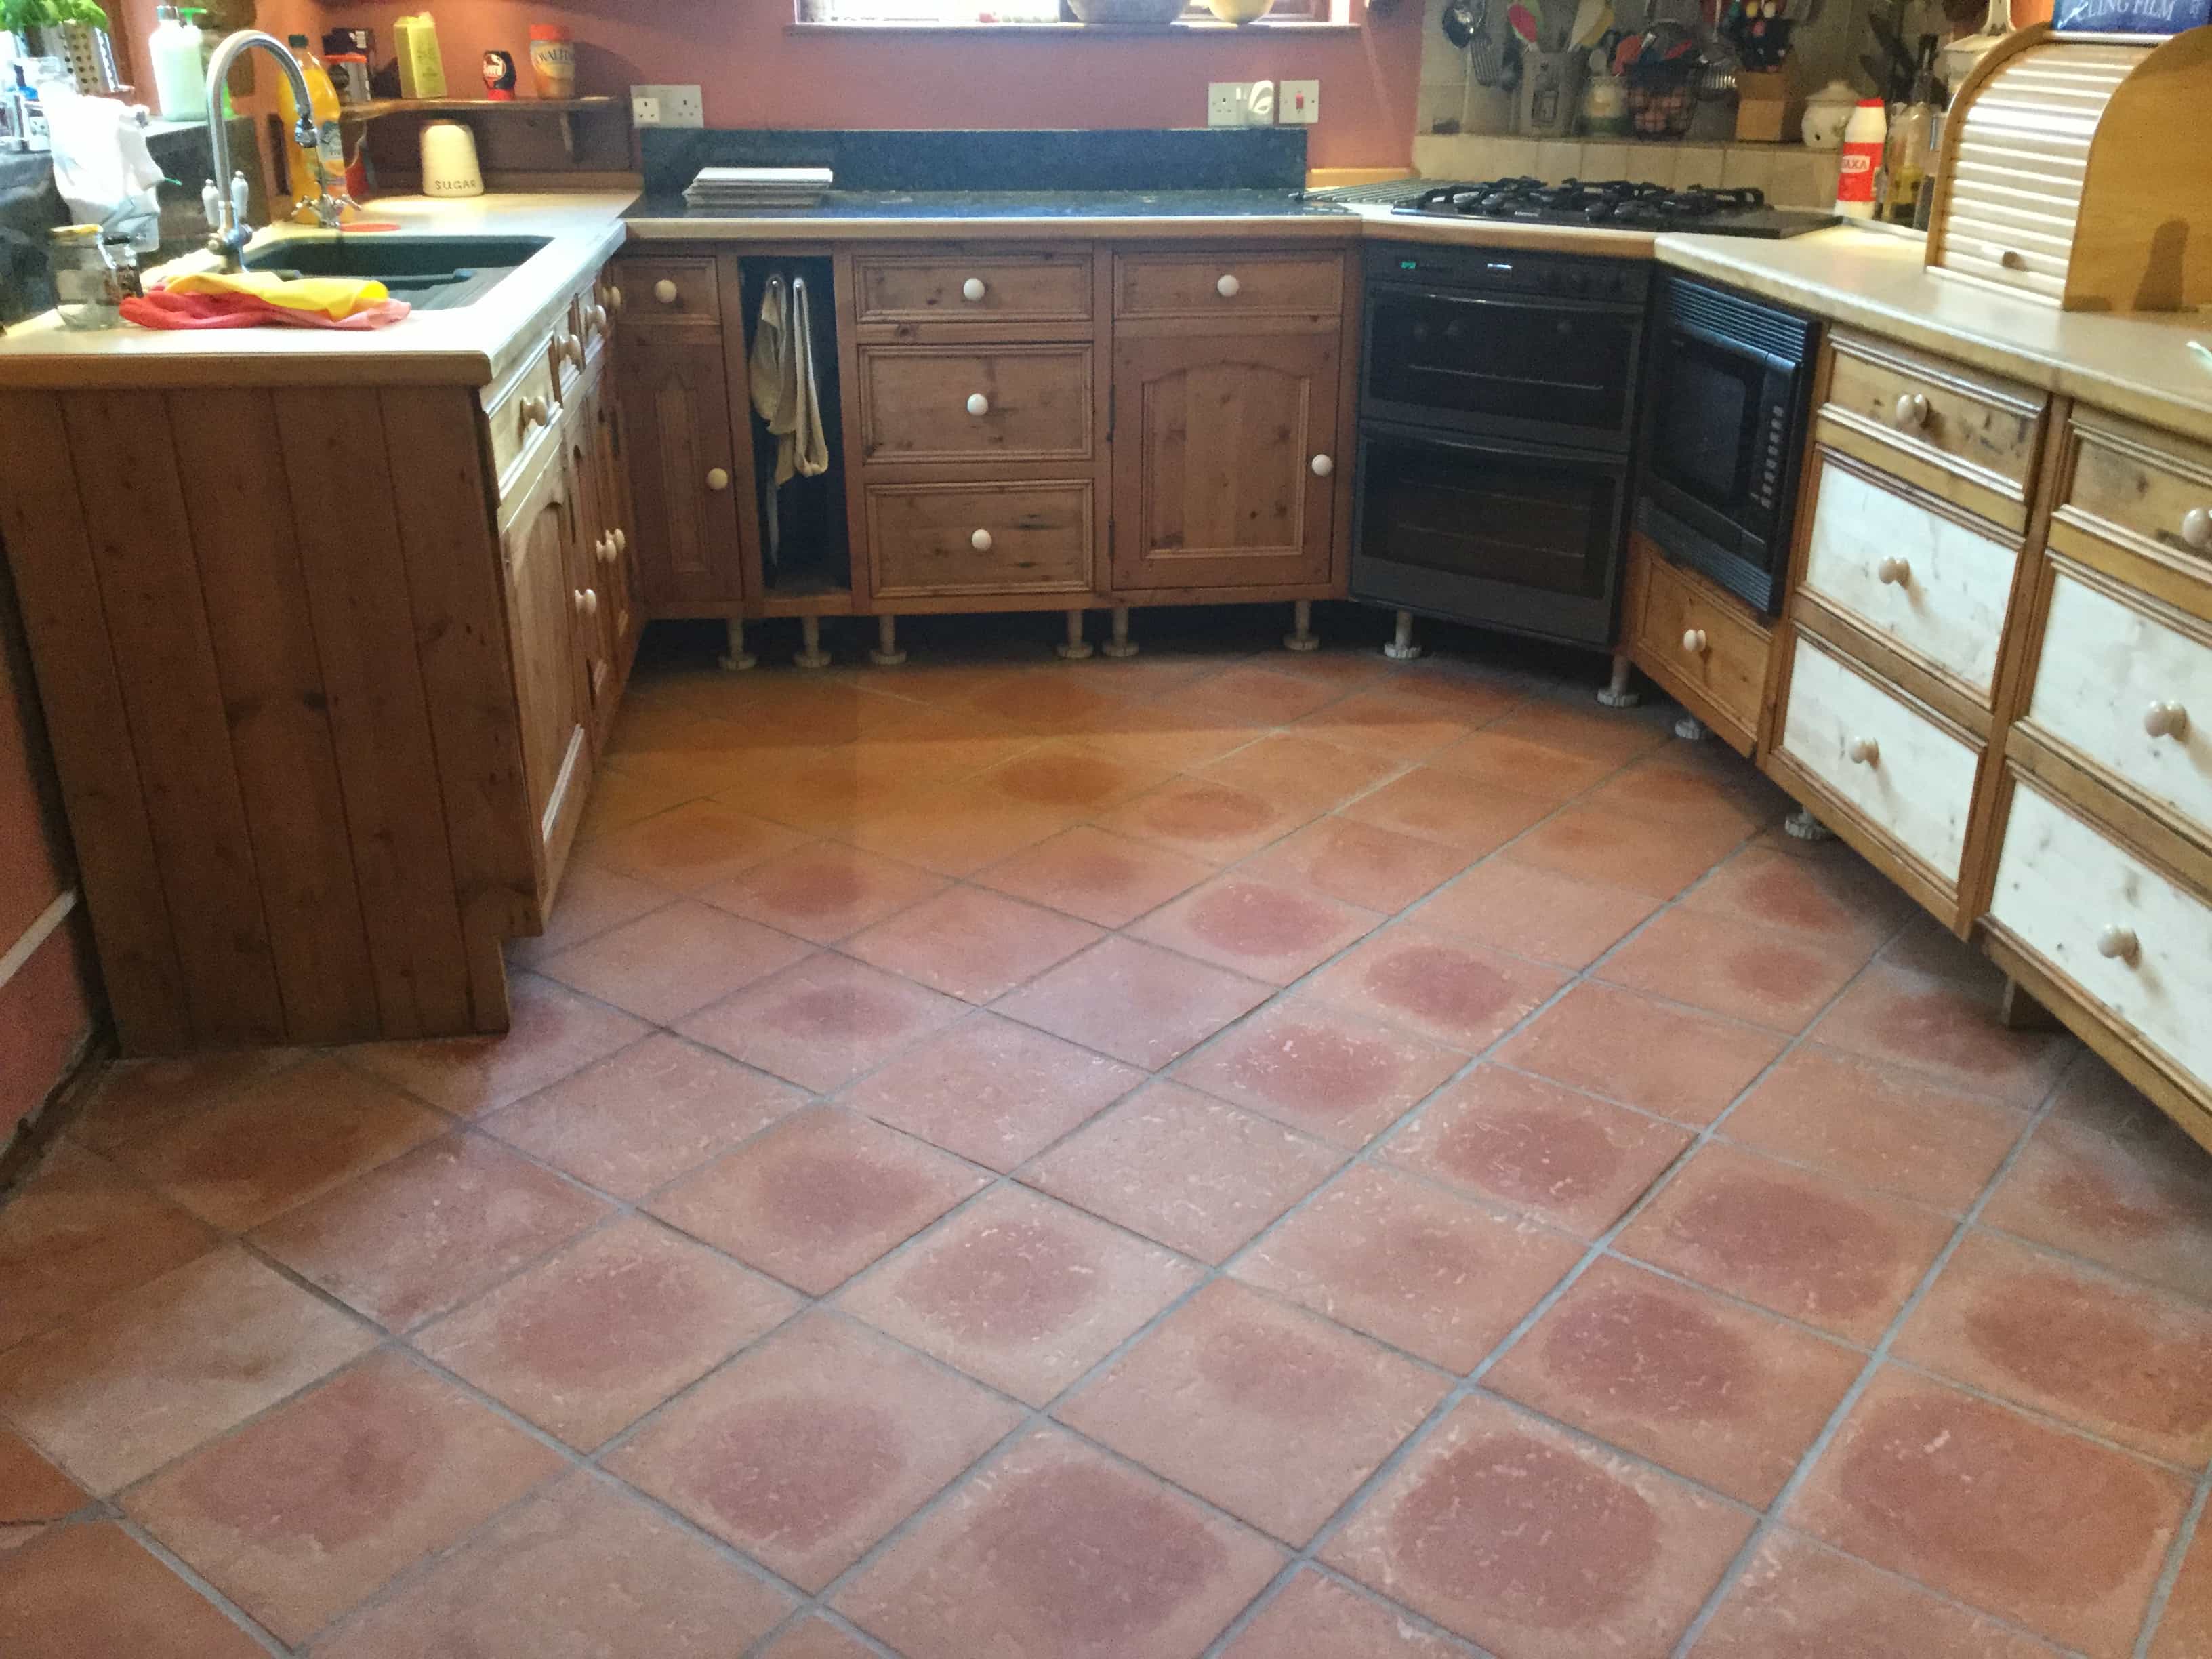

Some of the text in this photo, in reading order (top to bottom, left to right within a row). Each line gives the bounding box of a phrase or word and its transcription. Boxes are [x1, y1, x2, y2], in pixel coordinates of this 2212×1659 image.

[2075, 0, 2129, 21] CLING
[2132, 0, 2175, 21] FILM
[536, 48, 574, 64] OVALTIN
[434, 180, 476, 190] SUGAR
